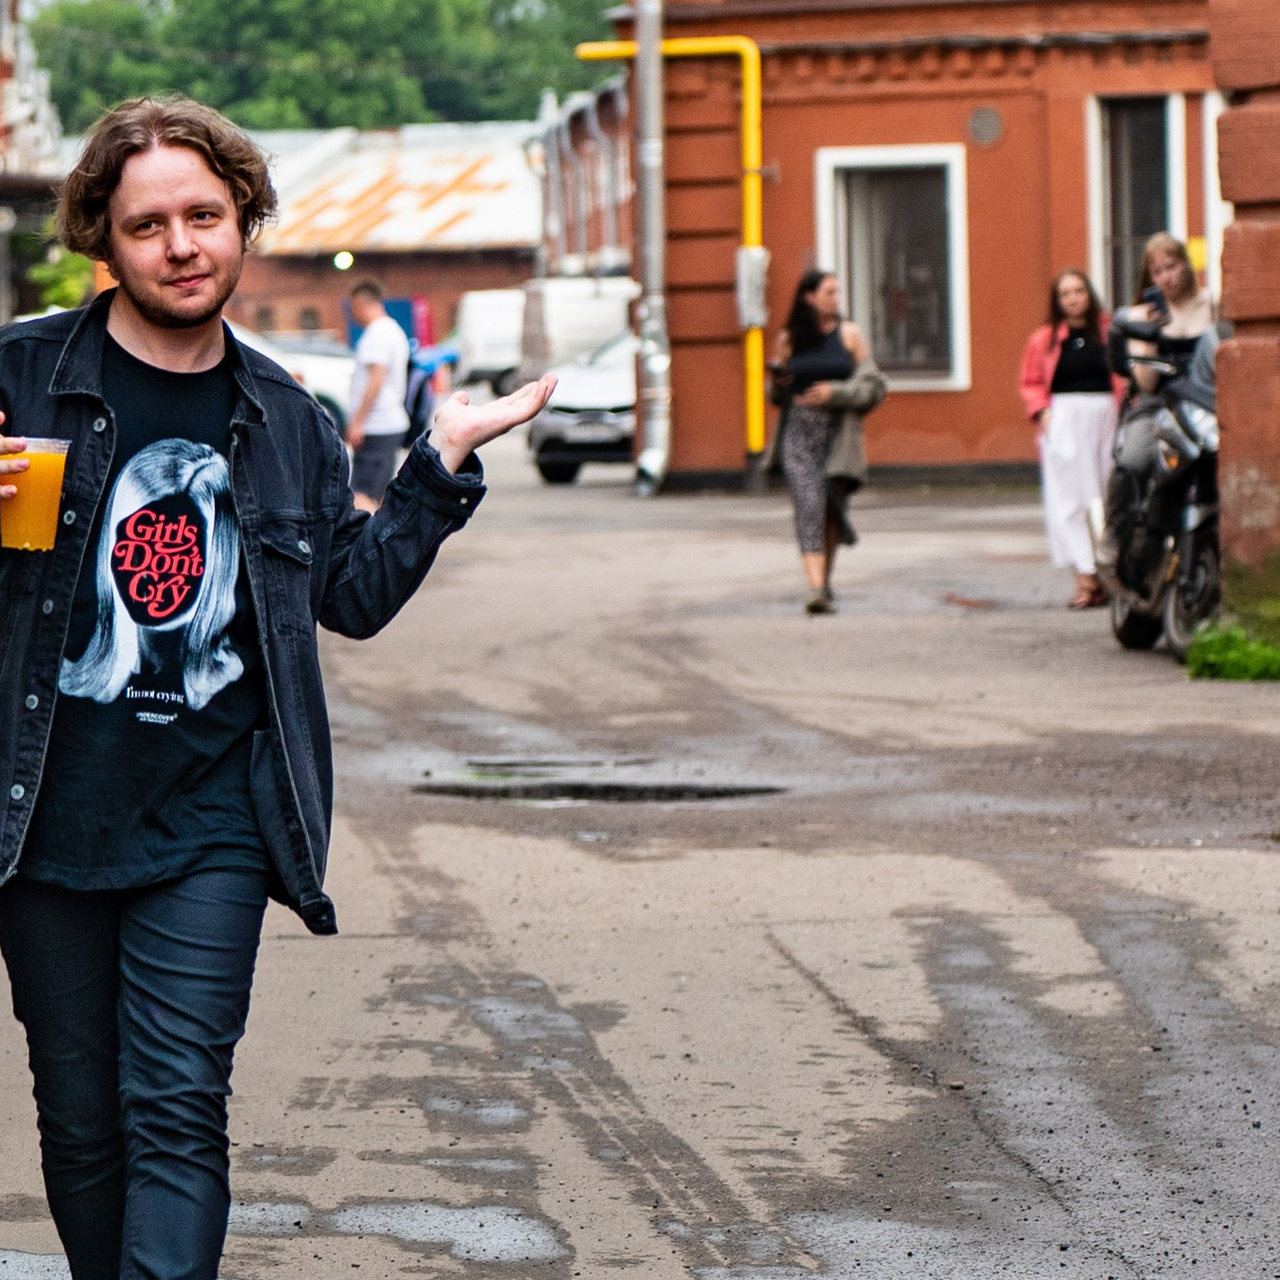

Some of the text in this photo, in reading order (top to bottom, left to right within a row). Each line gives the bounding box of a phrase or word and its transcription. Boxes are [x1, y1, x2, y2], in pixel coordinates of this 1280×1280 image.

[125, 509, 198, 554] Girls
[114, 540, 204, 577] Don't
[128, 570, 191, 618] Cry
[126, 685, 185, 704] I'm not crying
